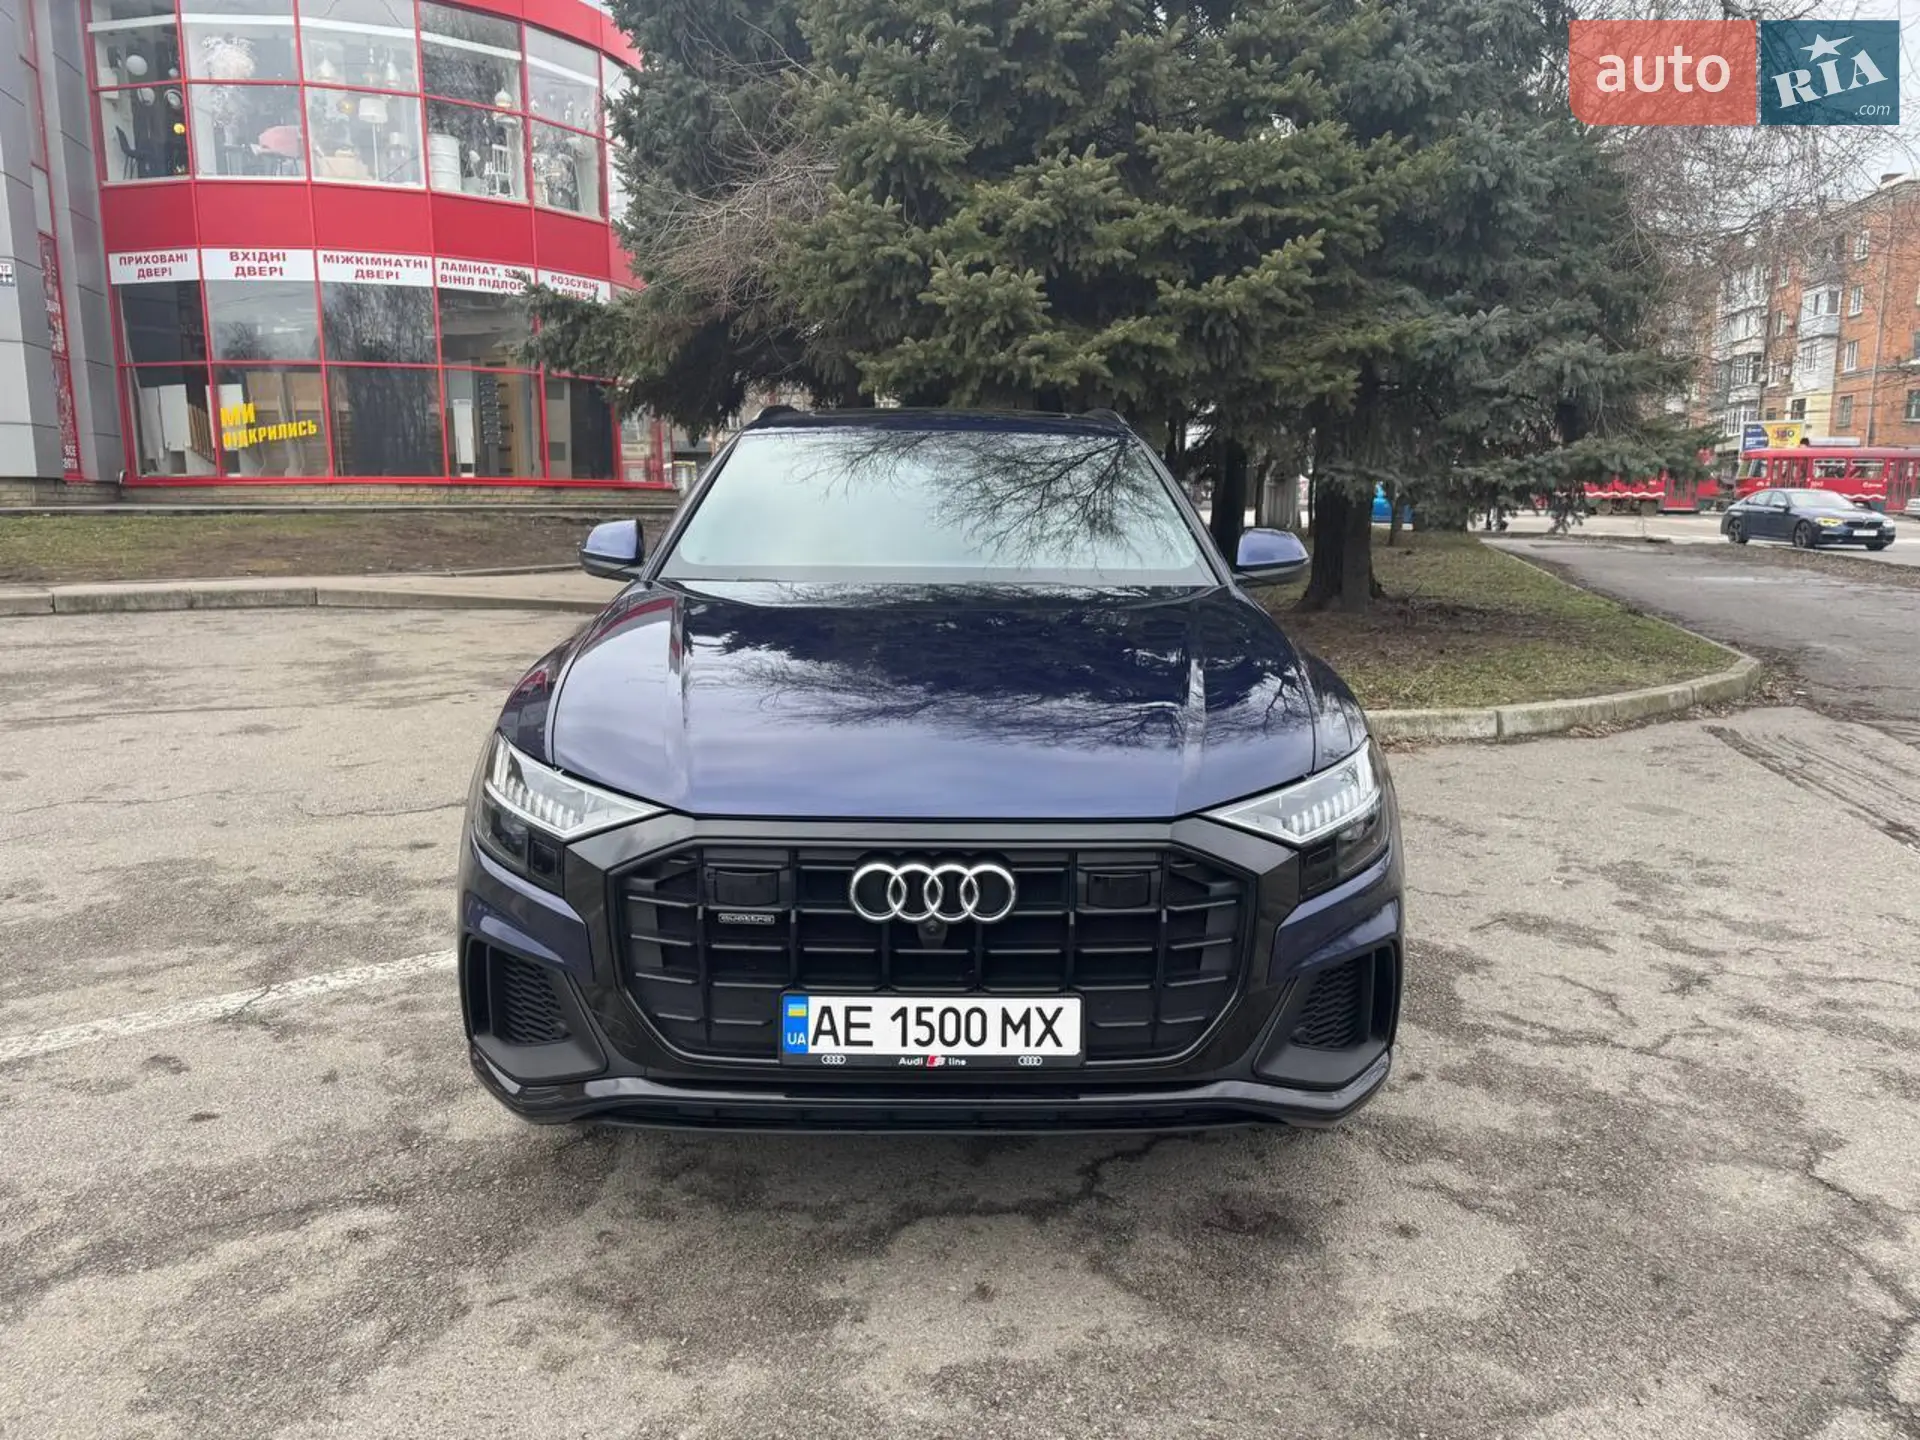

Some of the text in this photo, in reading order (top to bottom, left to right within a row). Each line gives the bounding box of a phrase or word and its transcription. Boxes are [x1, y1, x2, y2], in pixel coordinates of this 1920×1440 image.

[119, 253, 188, 266] ПРИХОВАНІ
[229, 251, 287, 263] ВХІДНІ
[323, 254, 428, 269] МІЖКІМНАТНІ
[137, 268, 172, 280] ДВЕРІ
[234, 266, 284, 278] ДВЕРІ
[355, 269, 400, 280] ДВЕРІ
[441, 261, 501, 277] ЛАМІНАТ,
[440, 275, 530, 291] ВІНІЛ ПІДЛОГ
[220, 402, 256, 428] МИ
[811, 1005, 1063, 1048] AE 1500 MX
[787, 1032, 806, 1045] UA
[899, 1057, 923, 1066] Audi
[948, 1057, 967, 1066] line
